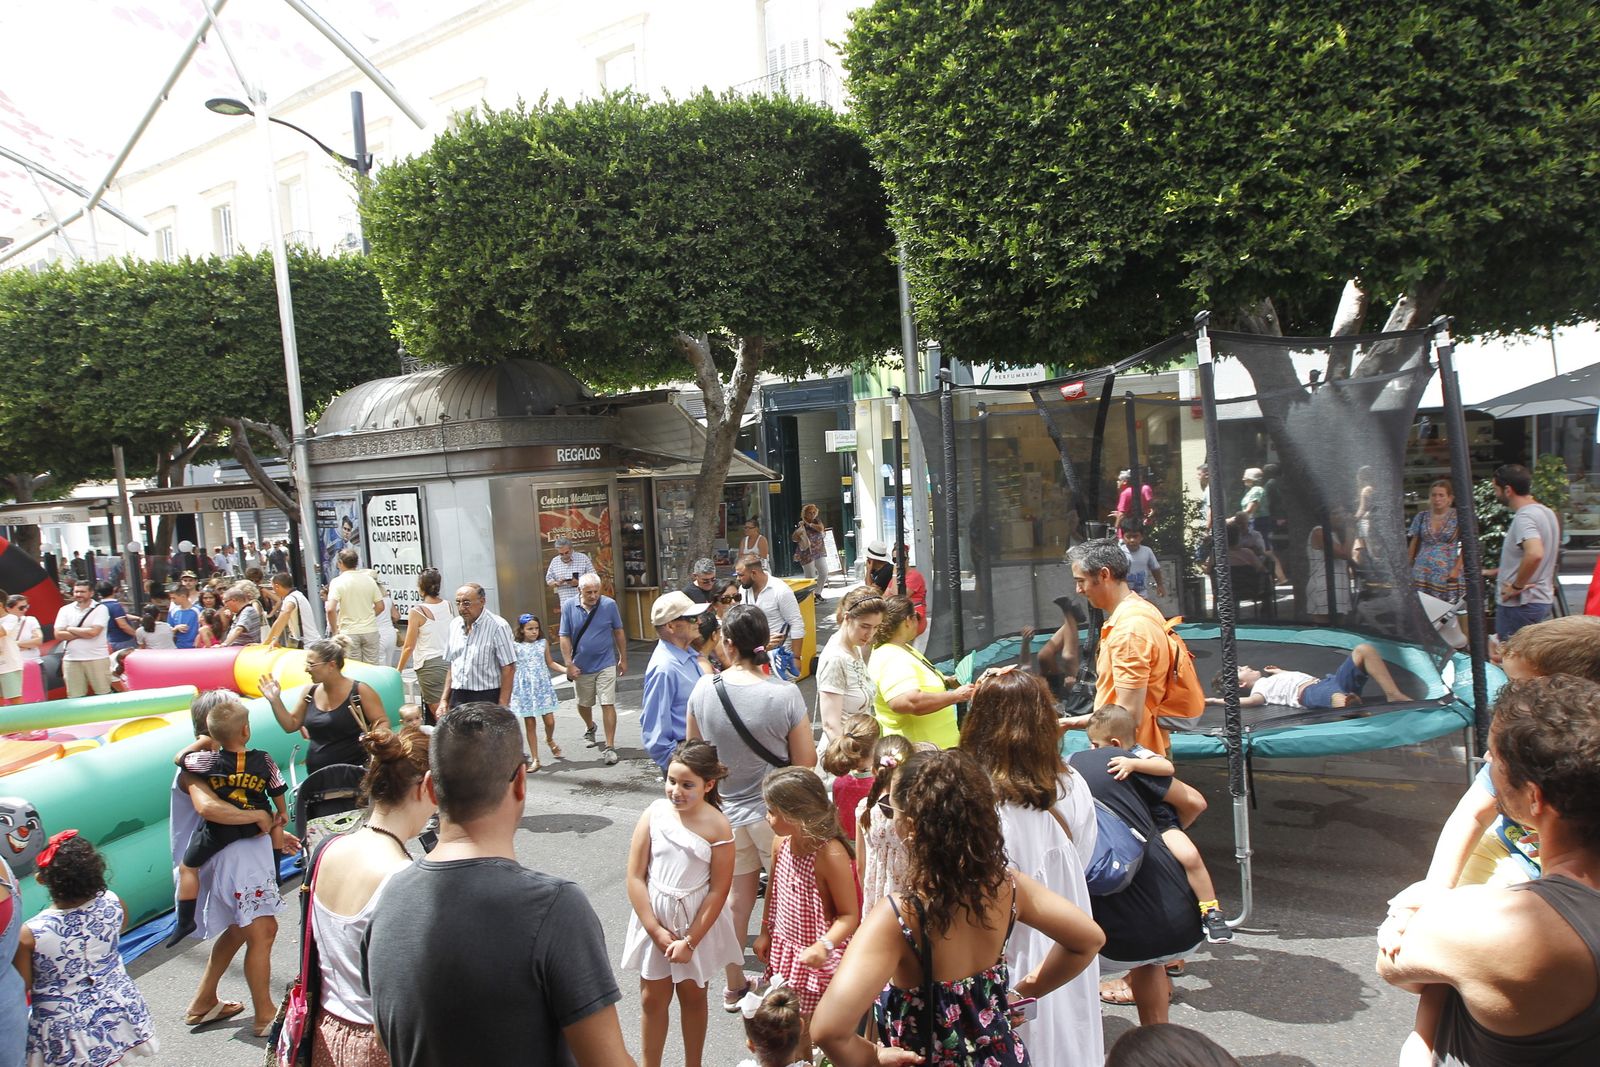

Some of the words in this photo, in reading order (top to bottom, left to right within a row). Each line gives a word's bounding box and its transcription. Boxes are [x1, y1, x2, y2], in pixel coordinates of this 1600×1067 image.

[557, 447, 601, 462] REGALOS
[137, 500, 184, 514] CAFETERIA
[211, 496, 258, 511] COIMBRA
[385, 500, 397, 511] SE
[540, 495, 569, 505] Cocina
[370, 515, 417, 527] NECESITA
[392, 548, 399, 558] Y
[373, 564, 423, 575] COCINERO
[393, 589, 409, 601] 246
[228, 773, 266, 792] STEGE
